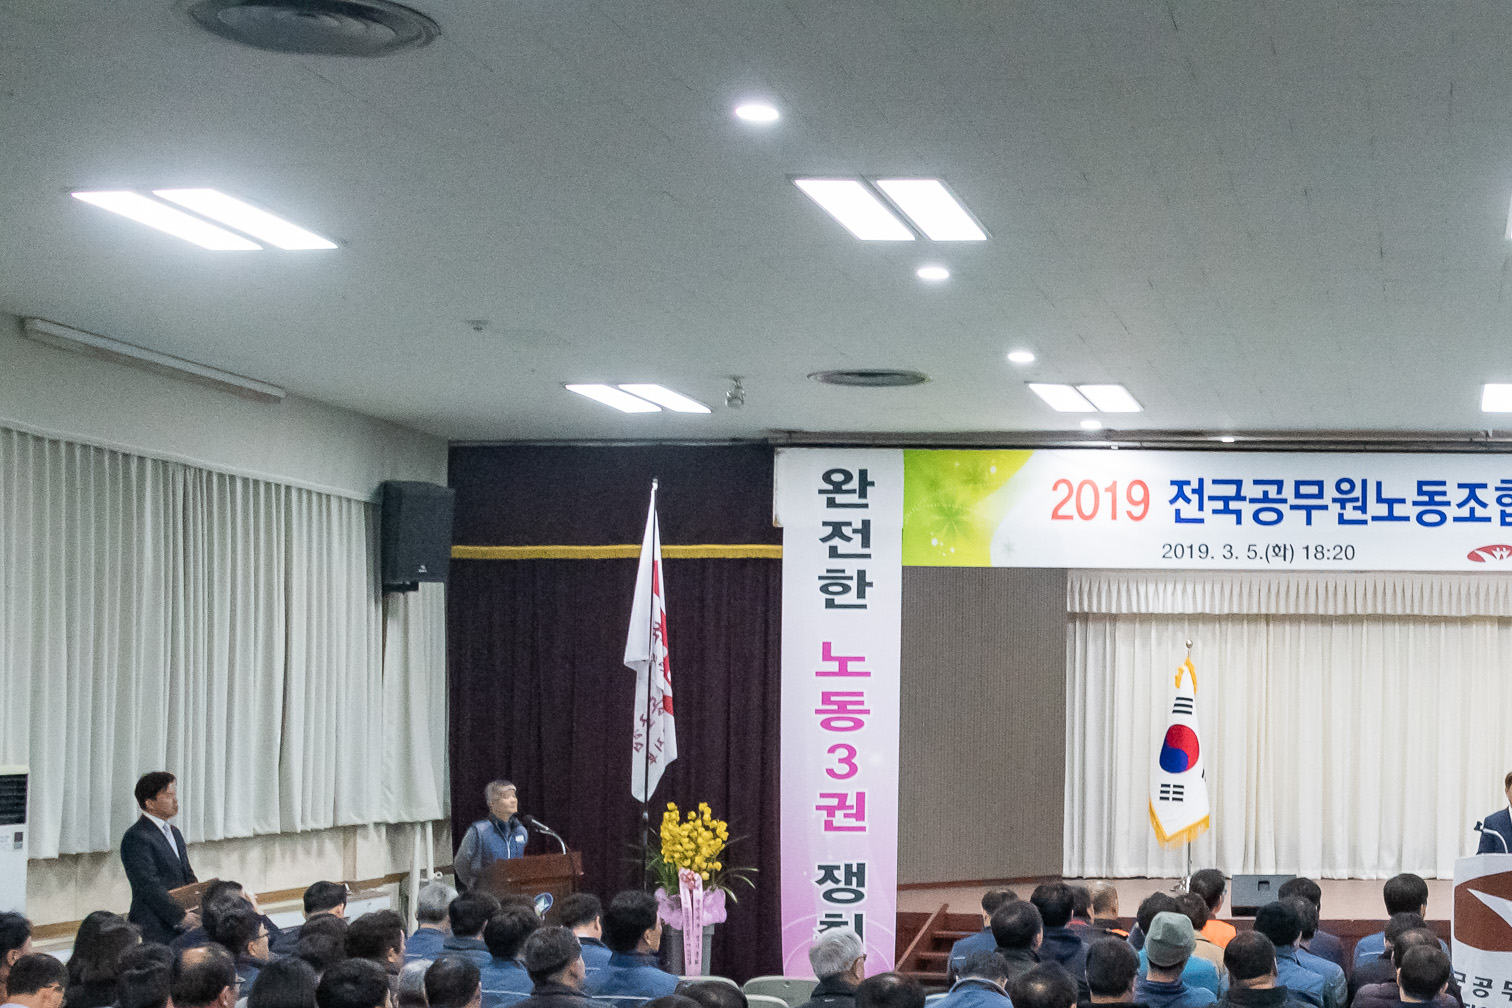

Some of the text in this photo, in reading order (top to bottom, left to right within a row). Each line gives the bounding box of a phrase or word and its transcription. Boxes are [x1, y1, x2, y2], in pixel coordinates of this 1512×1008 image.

[817, 468, 876, 610] 완전한
[1051, 478, 1151, 522] 2019
[1161, 542, 1356, 563] 2019. 3. 5.(화) 18:20
[815, 641, 872, 832] 노동3권
